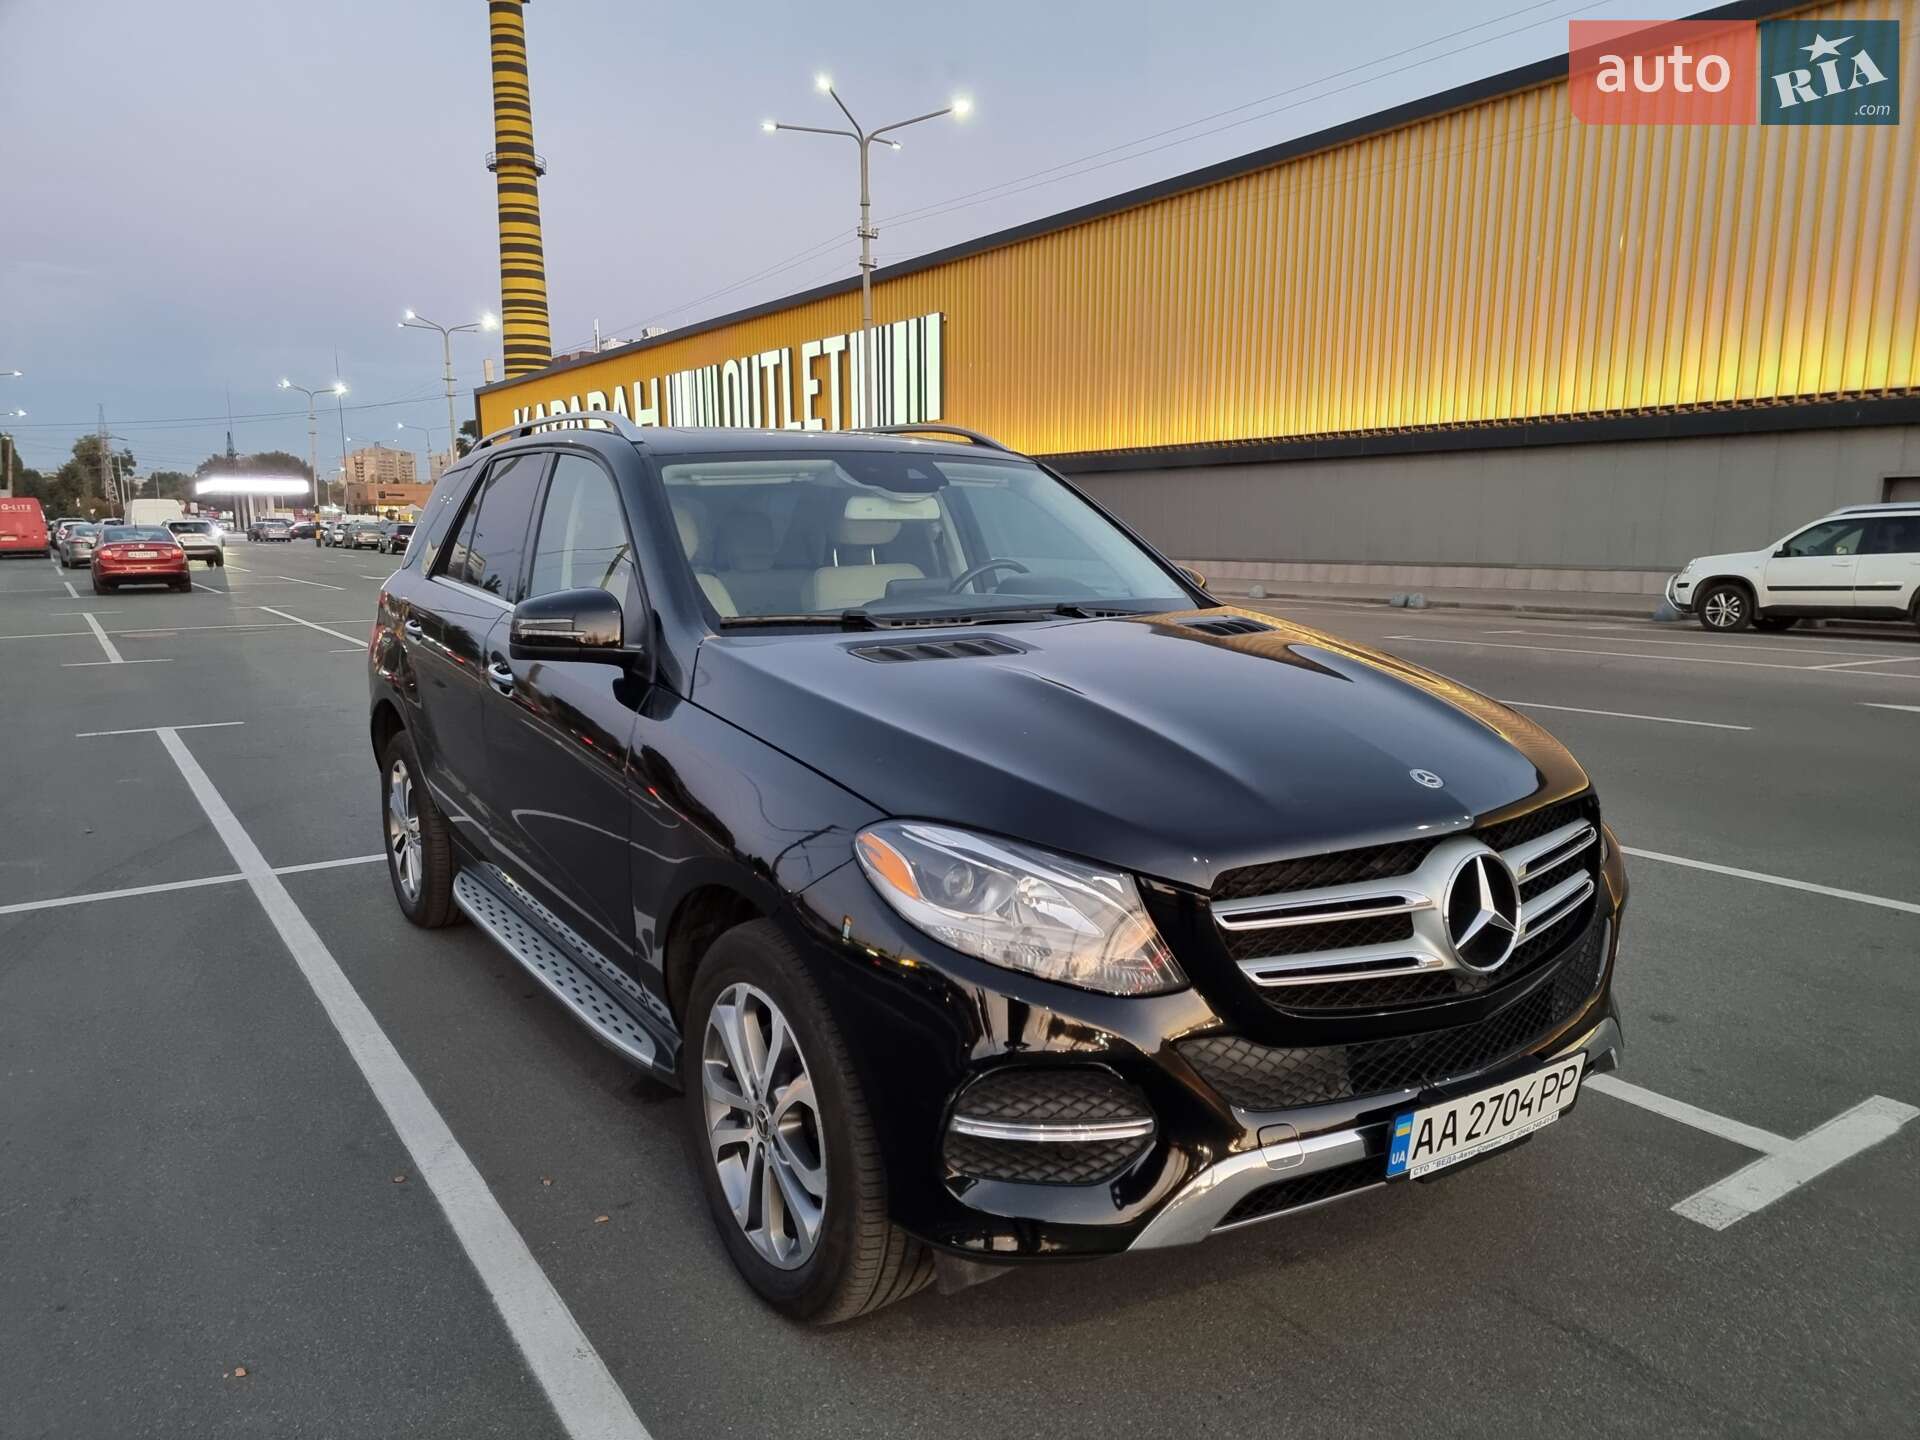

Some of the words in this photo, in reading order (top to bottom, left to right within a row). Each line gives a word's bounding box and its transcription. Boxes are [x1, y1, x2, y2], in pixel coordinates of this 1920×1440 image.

[722, 334, 846, 432] OUTLET
[1391, 1152, 1406, 1165] UA
[1412, 1110, 1457, 1160] AA
[1465, 1081, 1536, 1142] 2704
[1538, 1064, 1577, 1113] PP
